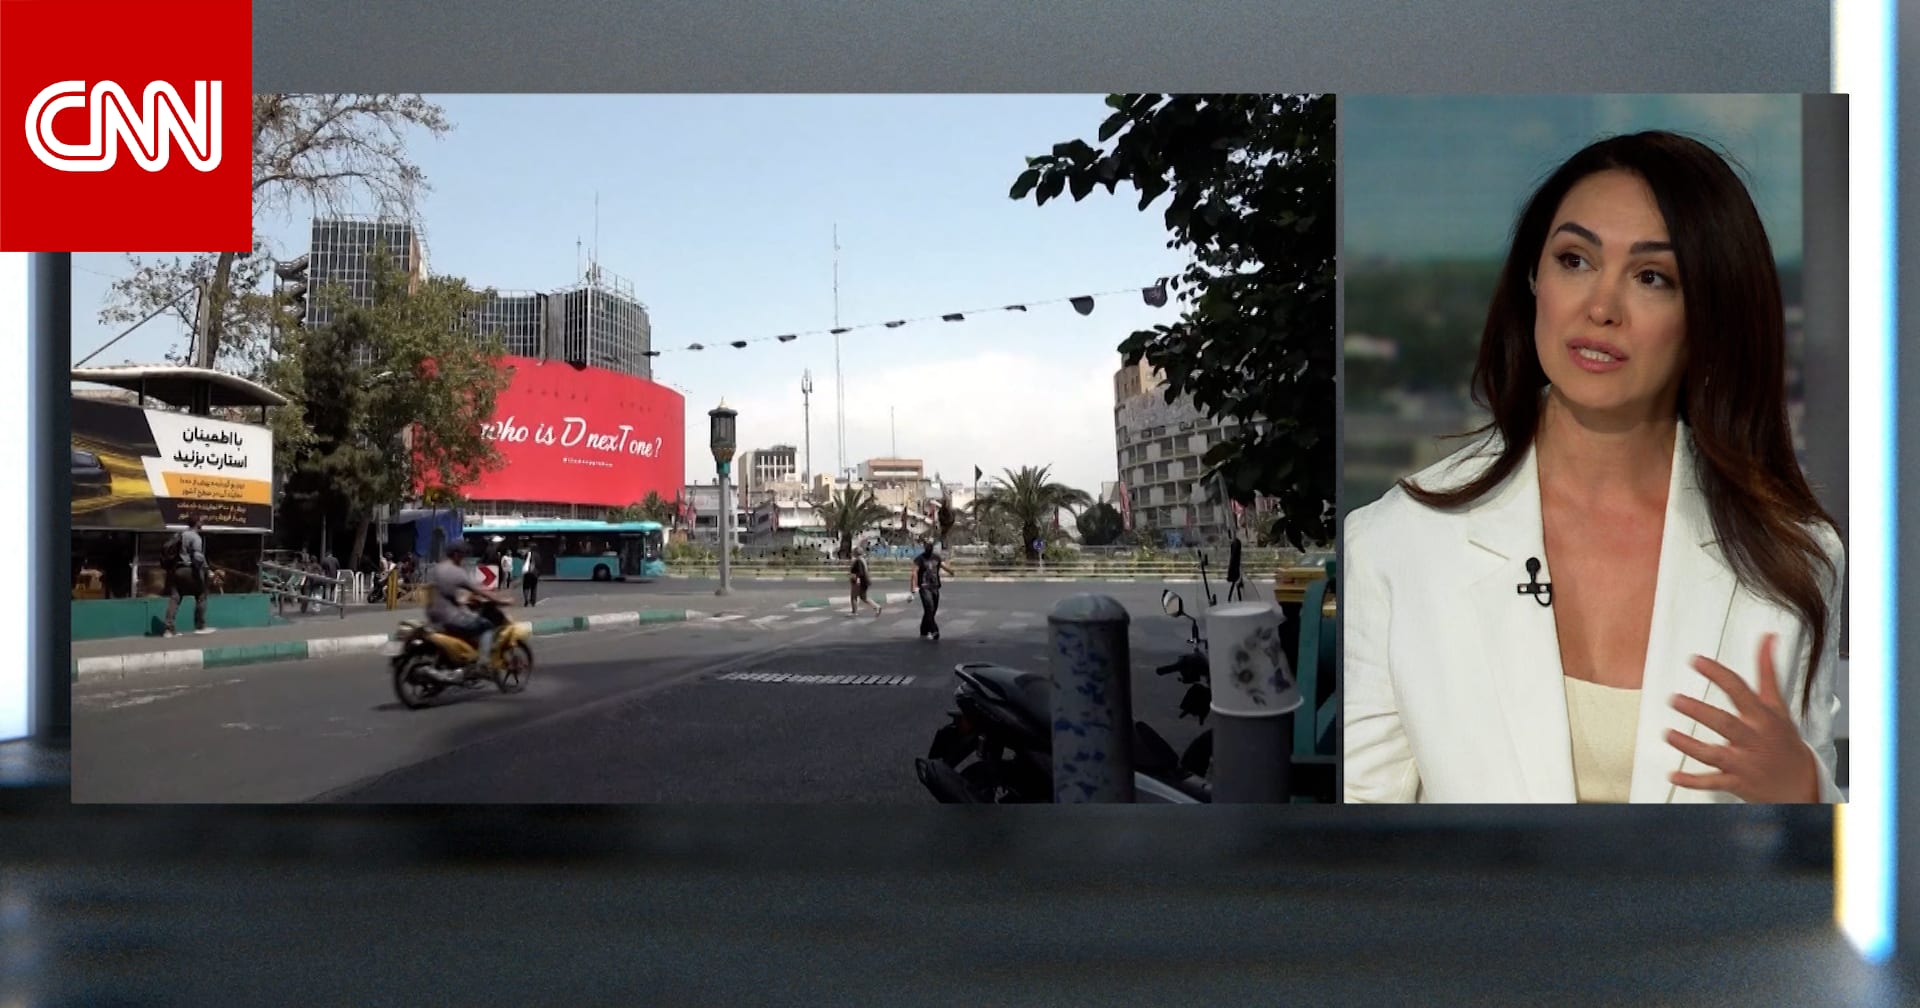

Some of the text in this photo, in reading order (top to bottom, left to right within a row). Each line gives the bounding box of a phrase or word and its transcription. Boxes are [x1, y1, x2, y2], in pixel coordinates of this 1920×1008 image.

[183, 426, 233, 447] اطمینان
[535, 423, 556, 446] is
[560, 416, 587, 447] D
[173, 449, 247, 470] استارت بزنید
